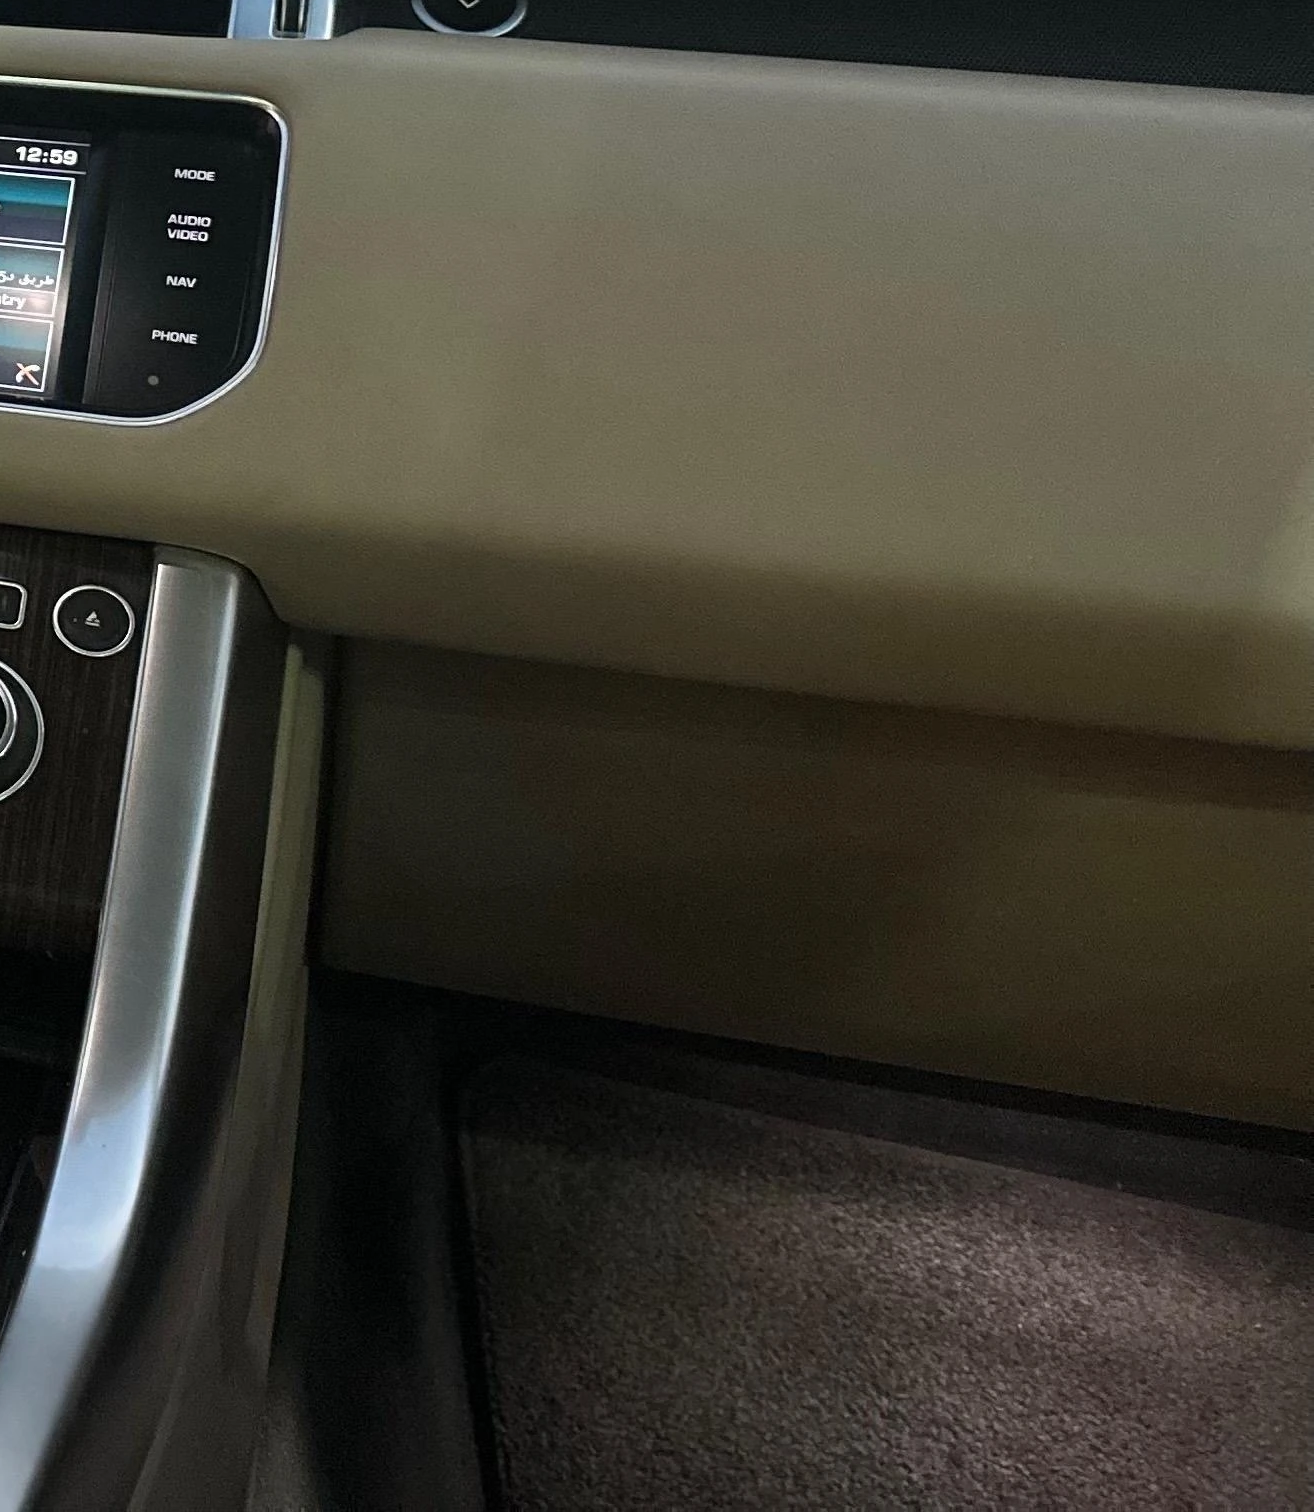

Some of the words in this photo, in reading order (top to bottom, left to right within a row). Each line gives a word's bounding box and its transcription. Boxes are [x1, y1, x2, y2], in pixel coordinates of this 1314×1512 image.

[15, 145, 80, 166] 12:59
[173, 167, 217, 182] MODE
[167, 213, 212, 228] AUDIO
[167, 228, 209, 242] VIDEO
[165, 275, 197, 289] NAV
[151, 329, 199, 345] PHONE
